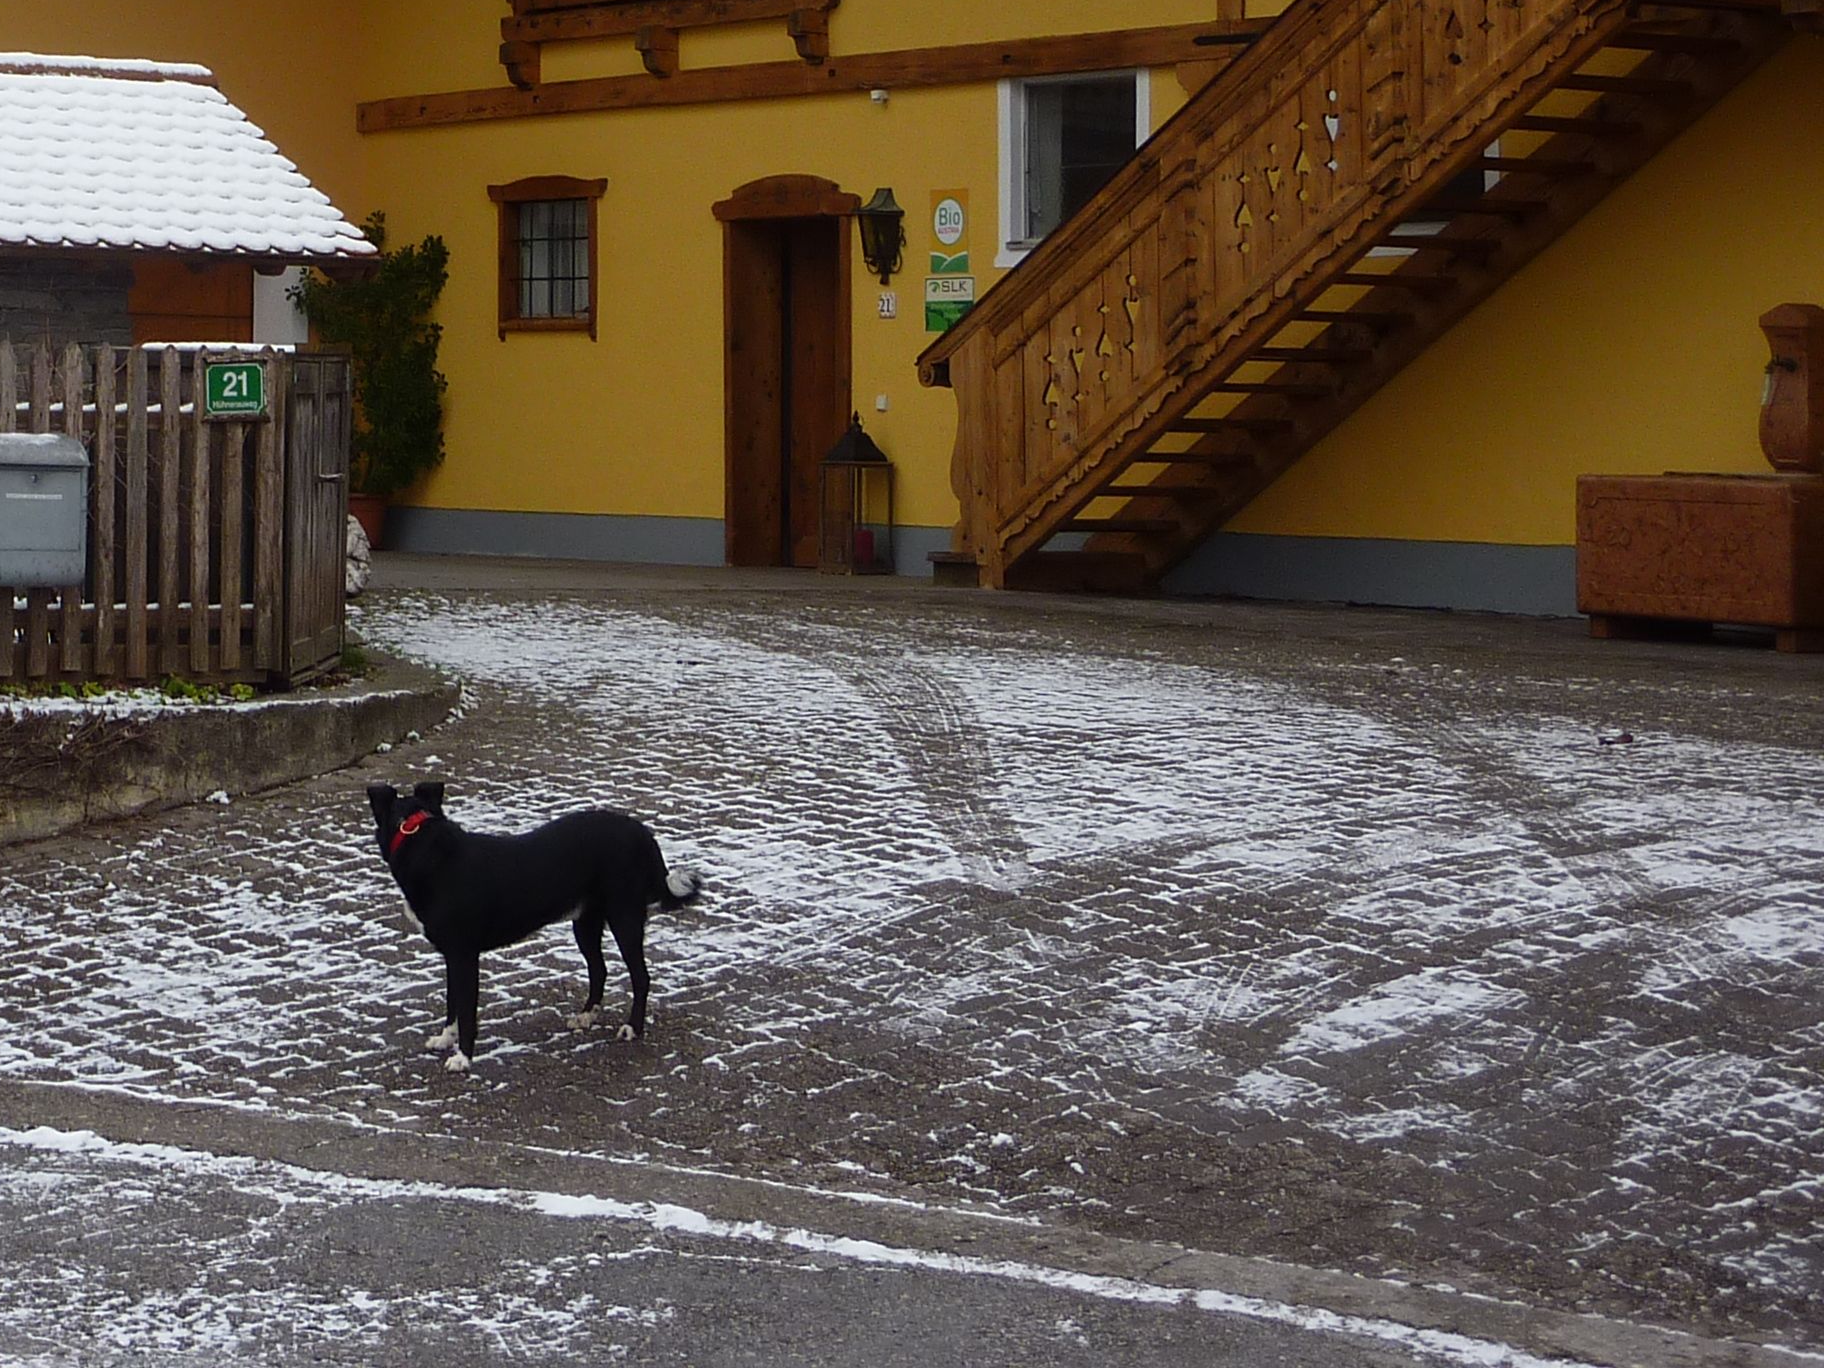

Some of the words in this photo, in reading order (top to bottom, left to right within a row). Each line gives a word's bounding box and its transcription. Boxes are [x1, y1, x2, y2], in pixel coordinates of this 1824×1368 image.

[939, 207, 960, 226] Bio
[941, 281, 967, 292] SLK
[879, 299, 891, 313] 21
[223, 371, 247, 396] 21
